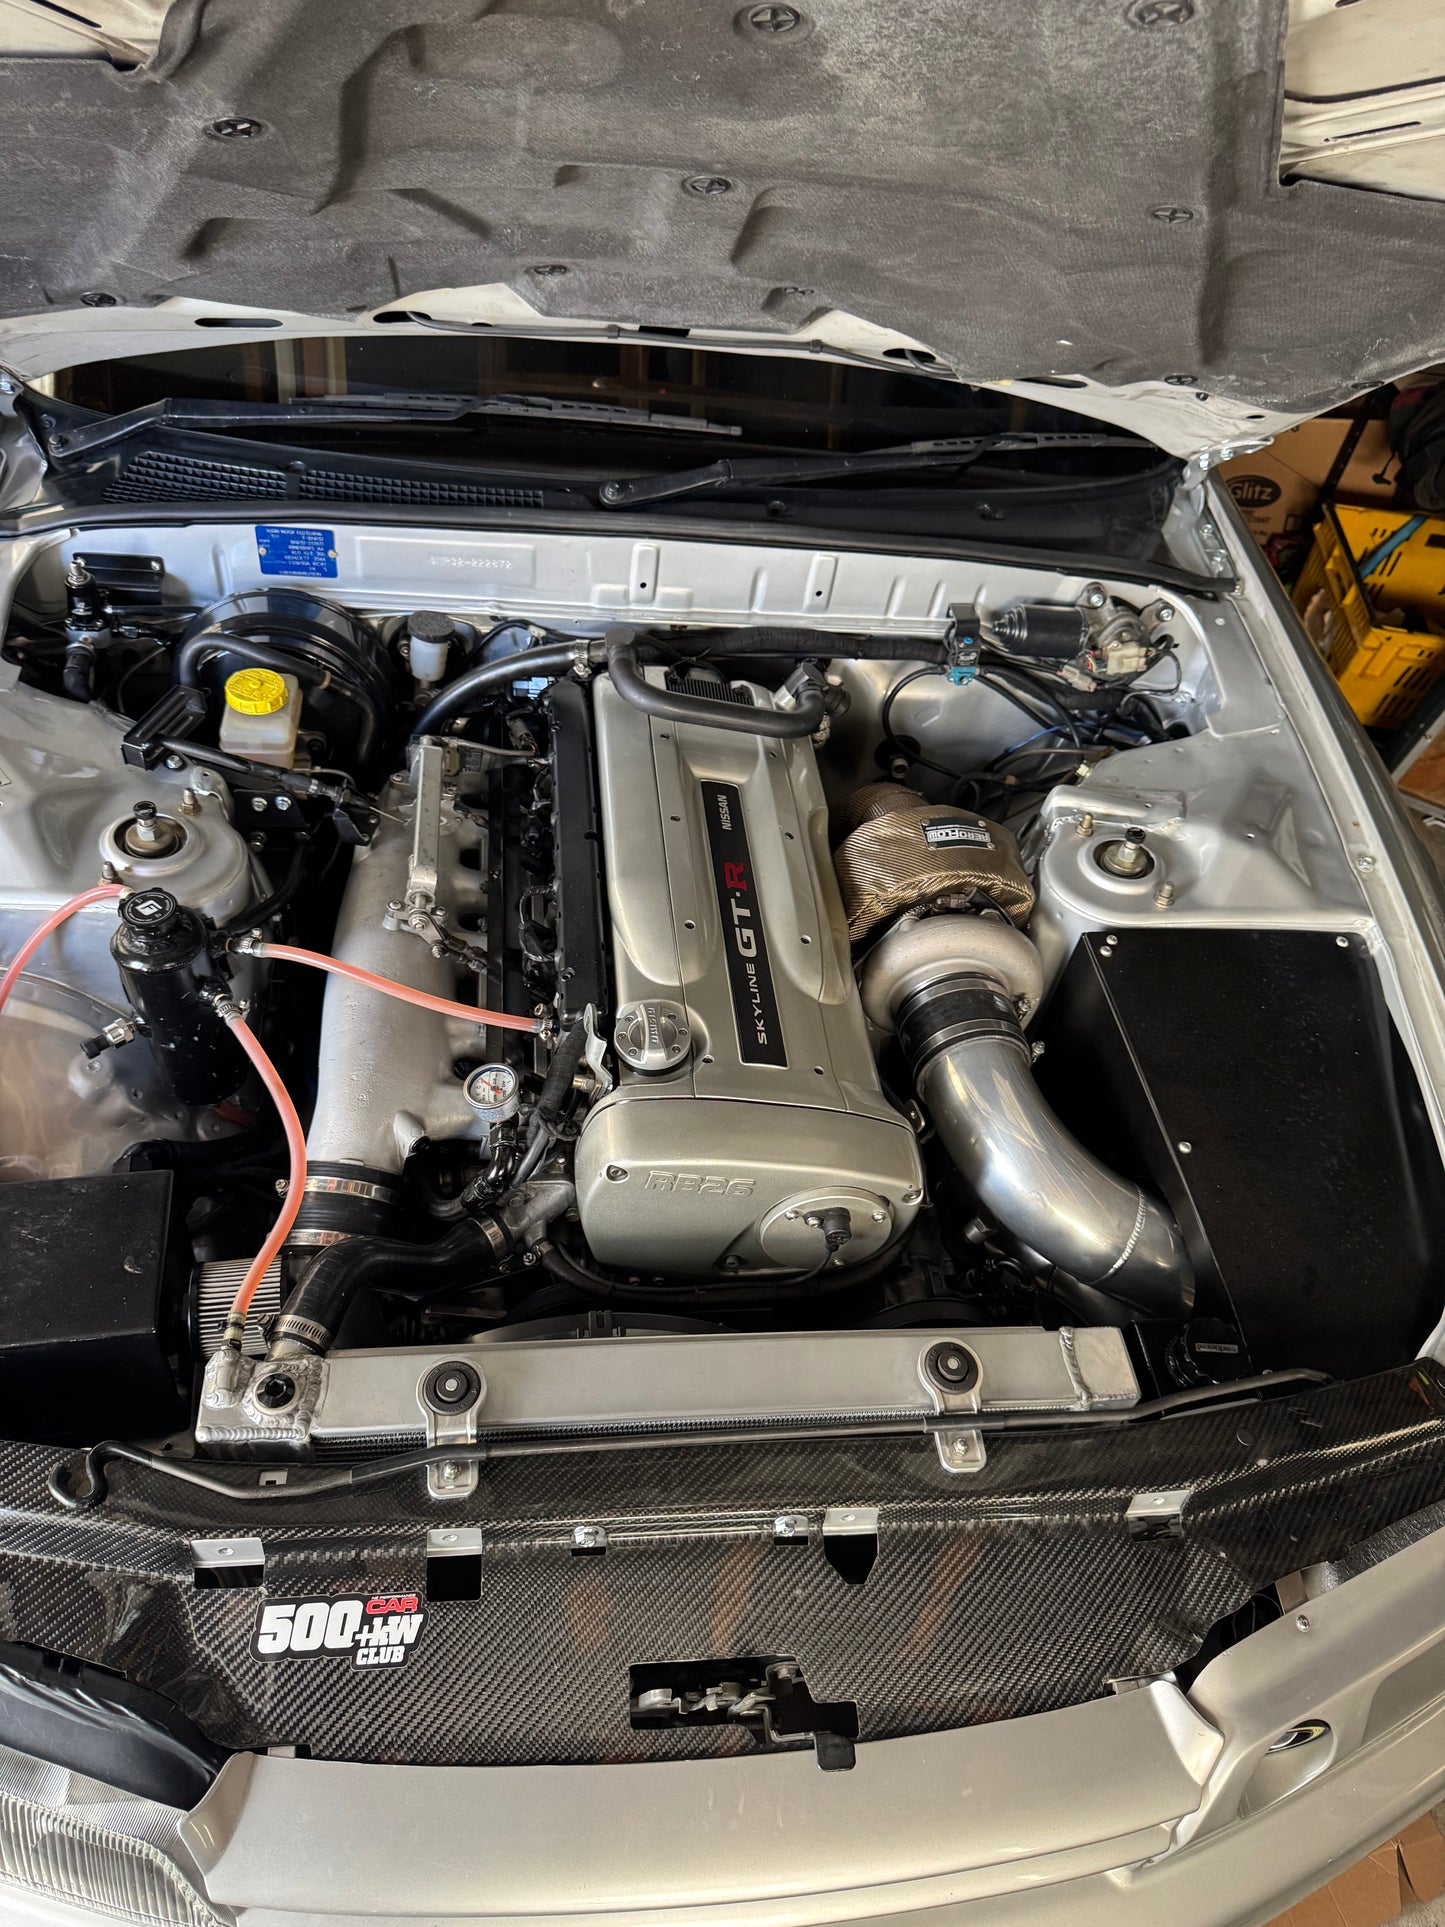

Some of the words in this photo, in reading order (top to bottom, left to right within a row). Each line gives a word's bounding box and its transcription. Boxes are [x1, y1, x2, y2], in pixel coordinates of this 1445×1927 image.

[1230, 482, 1273, 500] Glitz
[716, 794, 733, 831] NISSAN
[928, 829, 990, 842] AEROFLOW
[745, 962, 768, 1045] SKYLINE
[644, 1170, 756, 1197] RB26
[366, 1596, 419, 1615] CAR
[257, 1600, 364, 1654] 500
[355, 1645, 406, 1666] CLUB
